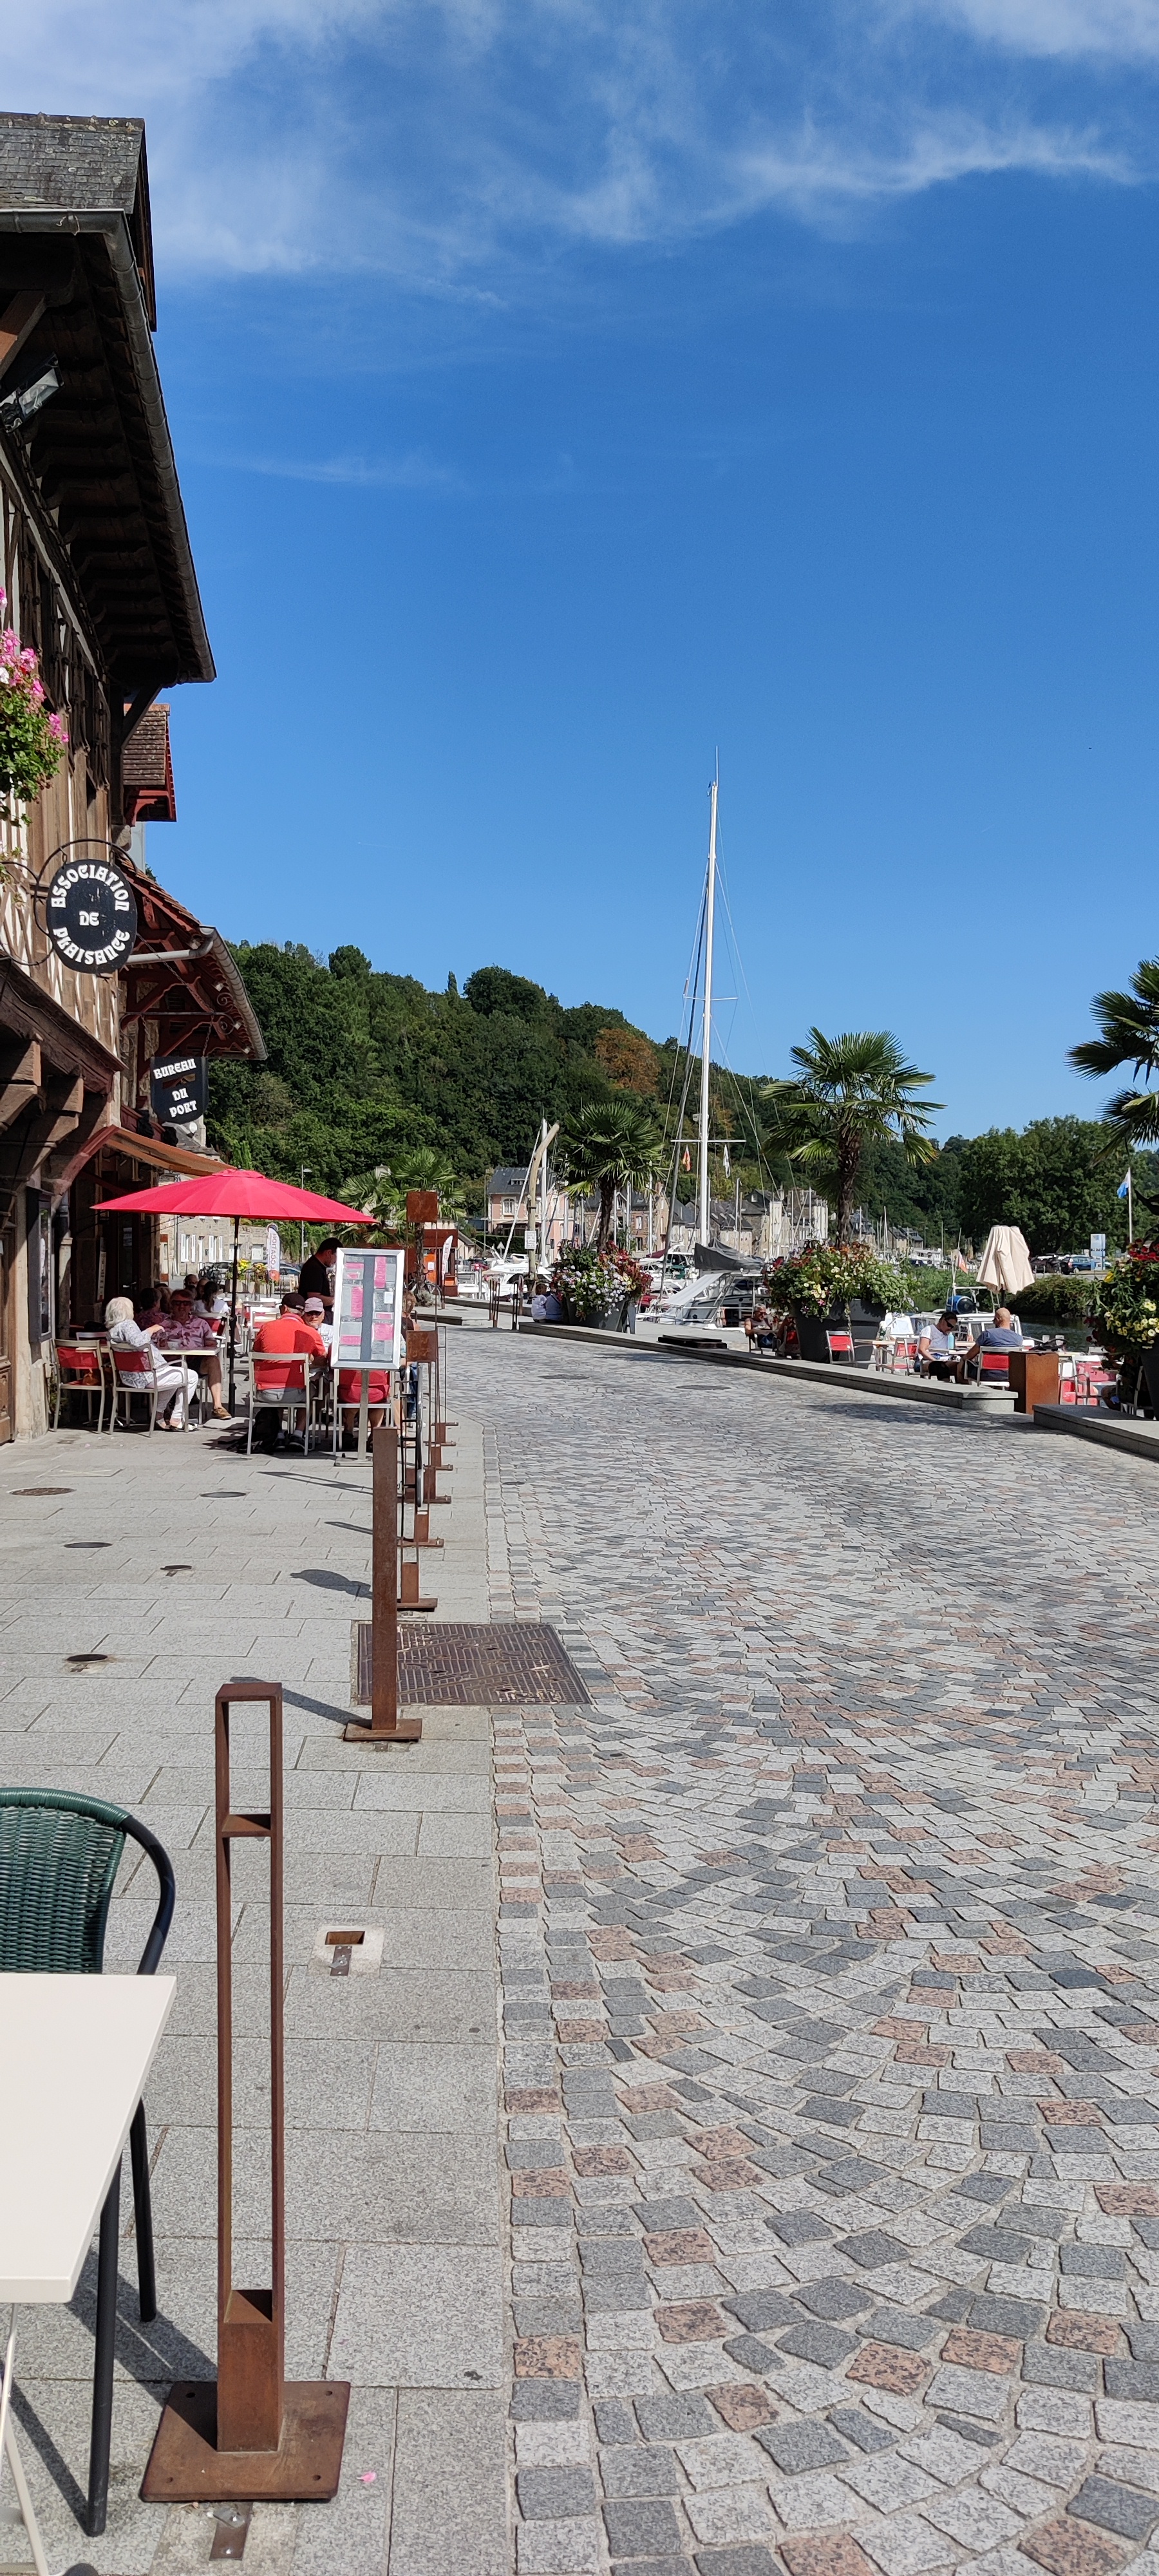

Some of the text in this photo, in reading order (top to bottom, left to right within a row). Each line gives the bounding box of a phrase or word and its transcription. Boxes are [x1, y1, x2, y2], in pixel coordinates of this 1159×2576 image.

[51, 864, 130, 911] ASSOCIATION
[79, 911, 100, 926] DE
[52, 927, 131, 965] PLAISANCE
[153, 1058, 196, 1079] BUREAU
[172, 1088, 189, 1101] DU
[169, 1100, 198, 1117] PORT
